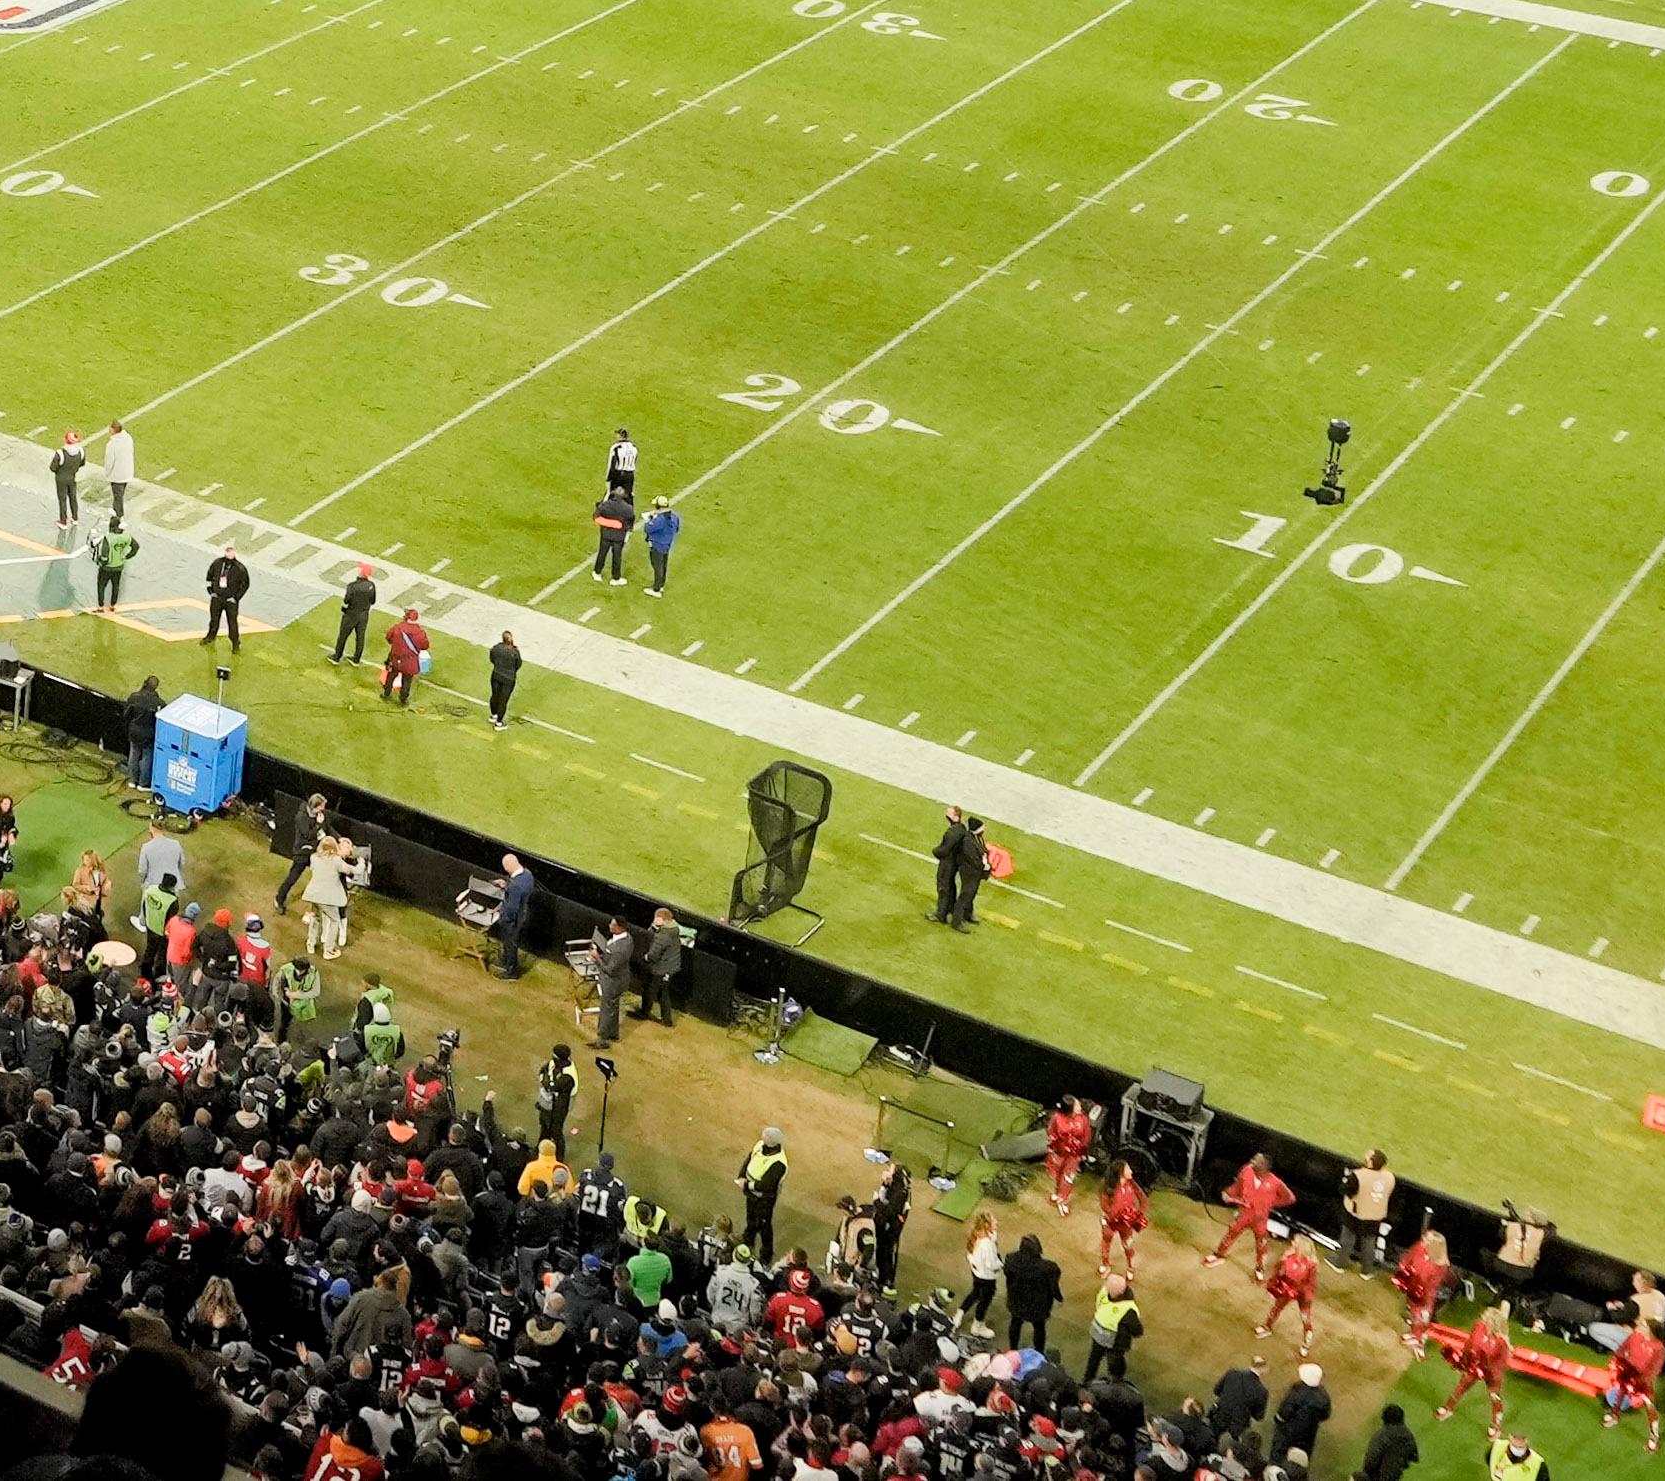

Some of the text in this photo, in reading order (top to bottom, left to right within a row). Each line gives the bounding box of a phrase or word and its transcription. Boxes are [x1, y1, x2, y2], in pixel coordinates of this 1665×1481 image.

[1166, 76, 1301, 123] 20
[296, 253, 453, 310] 30
[718, 372, 892, 437] 20
[1212, 509, 1405, 587] 10
[582, 1185, 609, 1215] 21
[722, 1286, 745, 1308] 24
[487, 1313, 511, 1340] 12
